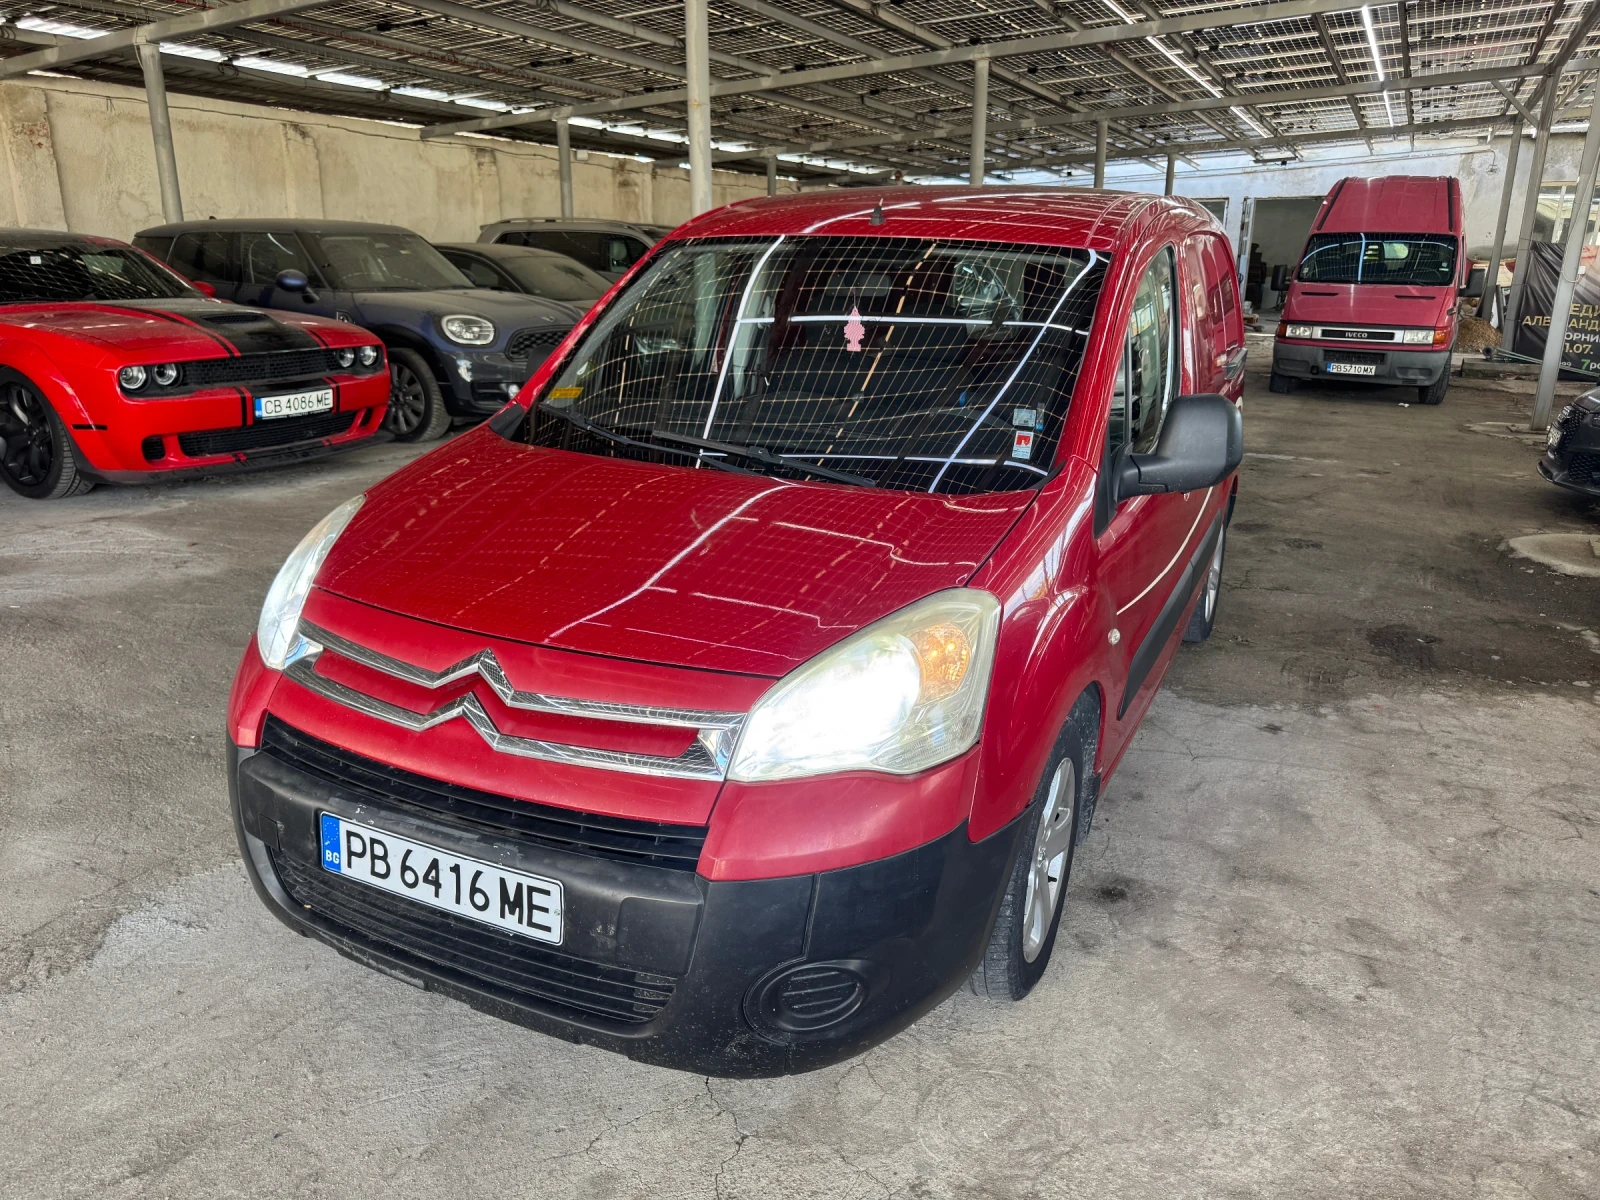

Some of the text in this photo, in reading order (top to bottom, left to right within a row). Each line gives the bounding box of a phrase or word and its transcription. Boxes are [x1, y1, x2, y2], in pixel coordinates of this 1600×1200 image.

[265, 399, 282, 415] CB
[285, 394, 314, 411] 4086
[316, 391, 331, 408] ME
[325, 849, 340, 865] BG
[345, 829, 552, 934] PB 6416 ME
